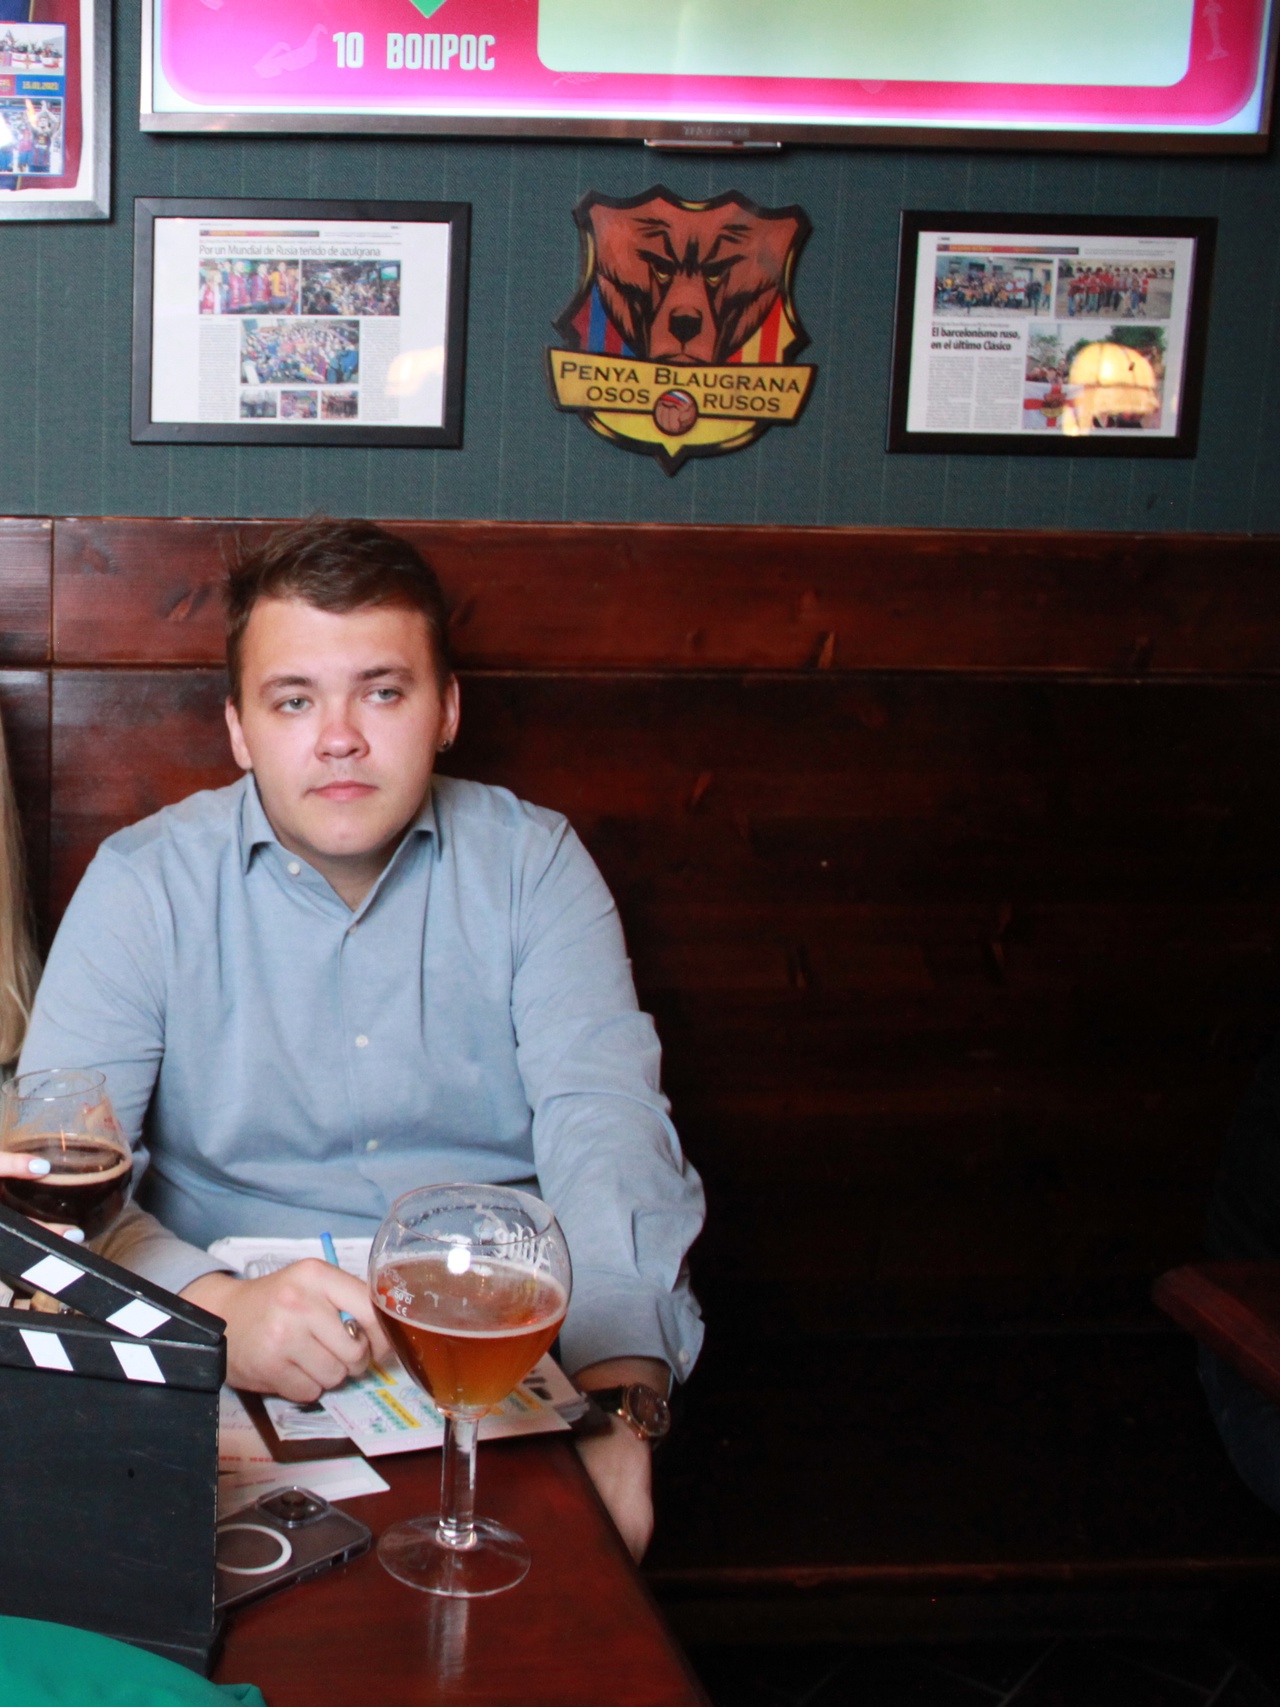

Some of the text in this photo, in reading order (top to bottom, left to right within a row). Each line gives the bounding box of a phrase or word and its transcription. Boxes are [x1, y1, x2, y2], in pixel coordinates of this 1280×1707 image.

[332, 31, 496, 71] 10 ВОПРОС
[199, 244, 214, 255] Por
[215, 247, 226, 255] un
[228, 244, 262, 255] Mundial
[264, 244, 274, 255] de
[276, 245, 298, 256] Rusia
[327, 246, 338, 256] de
[340, 246, 381, 258] azulgrana
[931, 326, 939, 337] El
[941, 327, 998, 338] barcelonismo
[930, 340, 941, 350] en
[943, 340, 952, 350] el
[560, 360, 801, 394] PENYA BLAUGRANA
[586, 385, 781, 412] OSOS RUSOS
